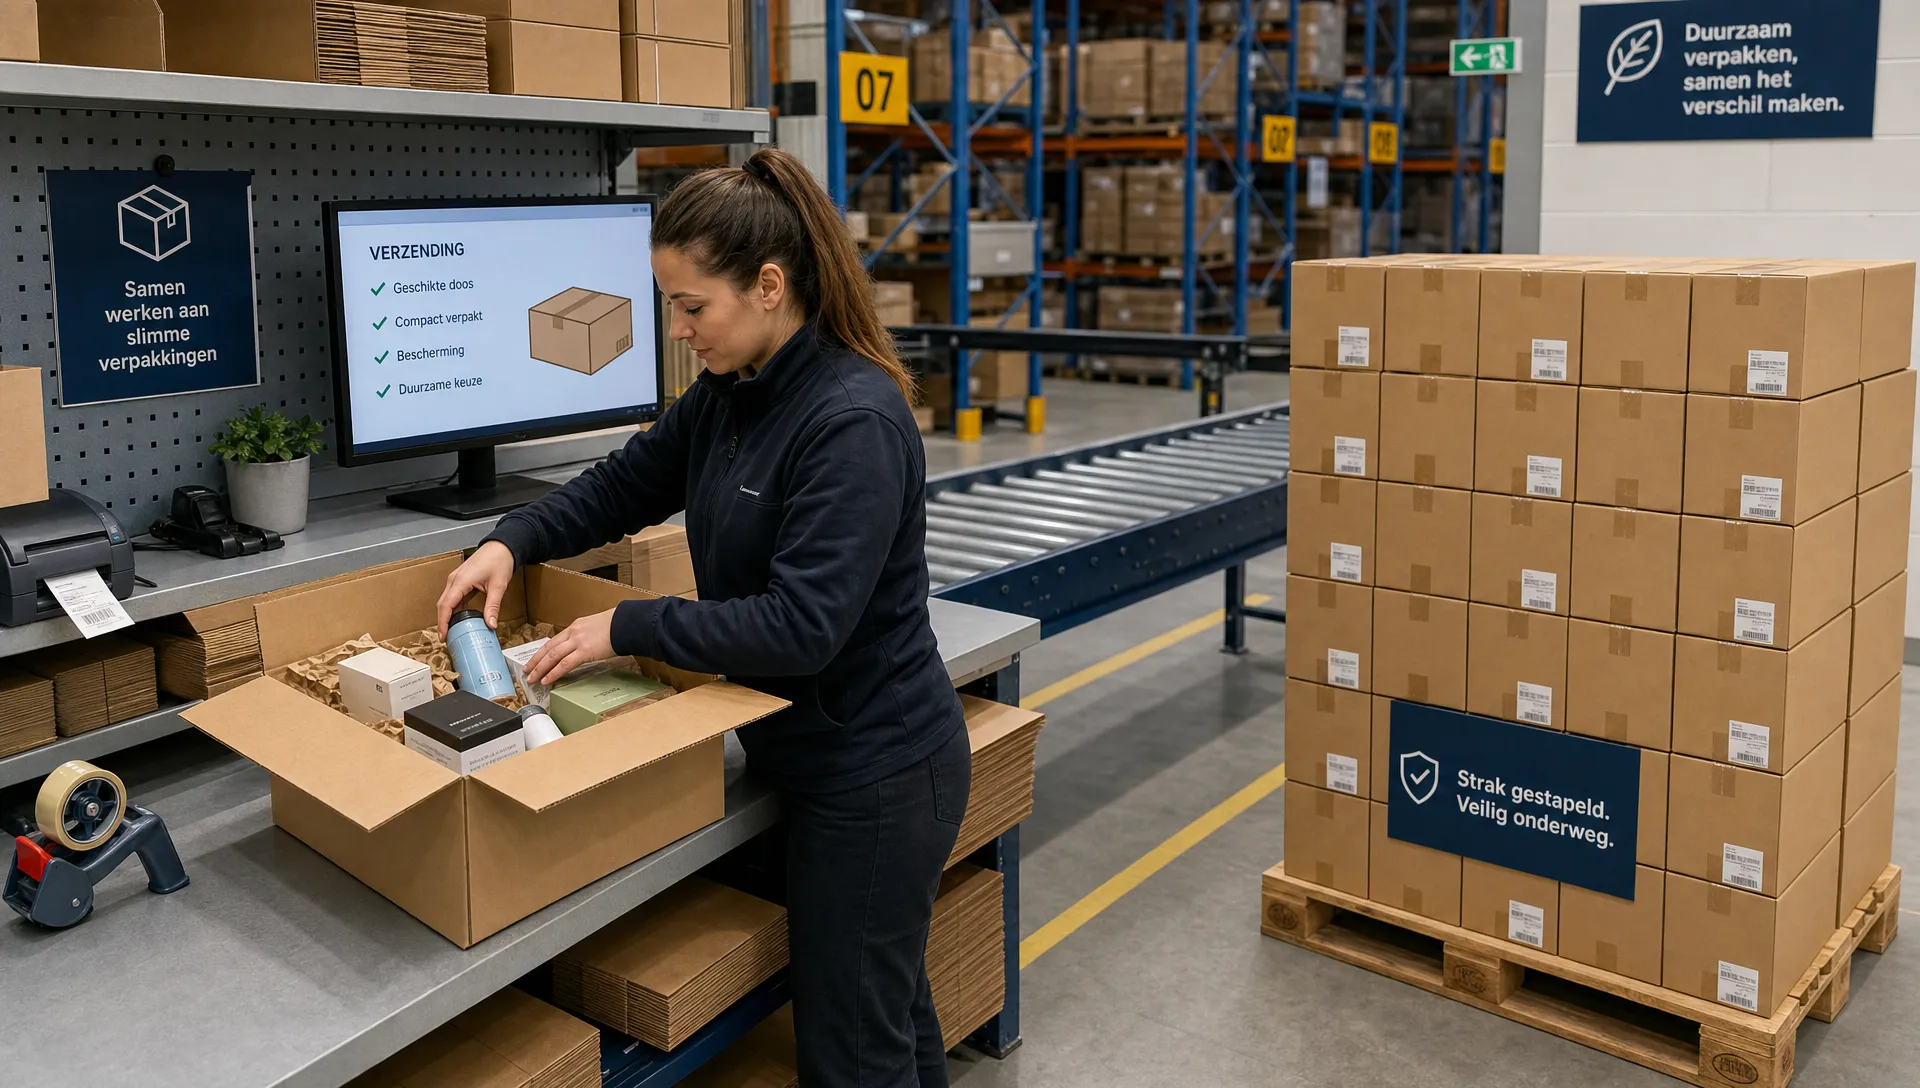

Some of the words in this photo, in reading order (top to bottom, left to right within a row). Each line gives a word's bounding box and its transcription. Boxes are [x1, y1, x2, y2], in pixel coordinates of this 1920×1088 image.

[1685, 22, 1792, 42] Duurzaam
[1684, 45, 1798, 70] verpakken,
[857, 68, 894, 112] 07
[1683, 74, 1751, 92] samen
[1757, 69, 1792, 89] het
[1682, 94, 1763, 115] verschil
[1768, 93, 1845, 113] maken.
[369, 242, 465, 261] VERZENDING
[125, 280, 185, 298] Samen
[393, 280, 446, 294] Geschikte
[449, 279, 474, 290] doos
[105, 304, 174, 323] werken
[179, 304, 209, 318] aan
[395, 313, 443, 328] Compact
[446, 310, 483, 324] verpakt
[127, 327, 190, 346] slimme
[98, 348, 217, 373] verpakkingen
[397, 345, 465, 361] Bescherming
[399, 380, 451, 395] Duurzame
[454, 376, 482, 388] keuze
[1457, 769, 1506, 796] Strak
[1511, 785, 1610, 820] gestapeld.
[1456, 794, 1508, 826] Veilig
[1513, 811, 1614, 849] onderweg.
